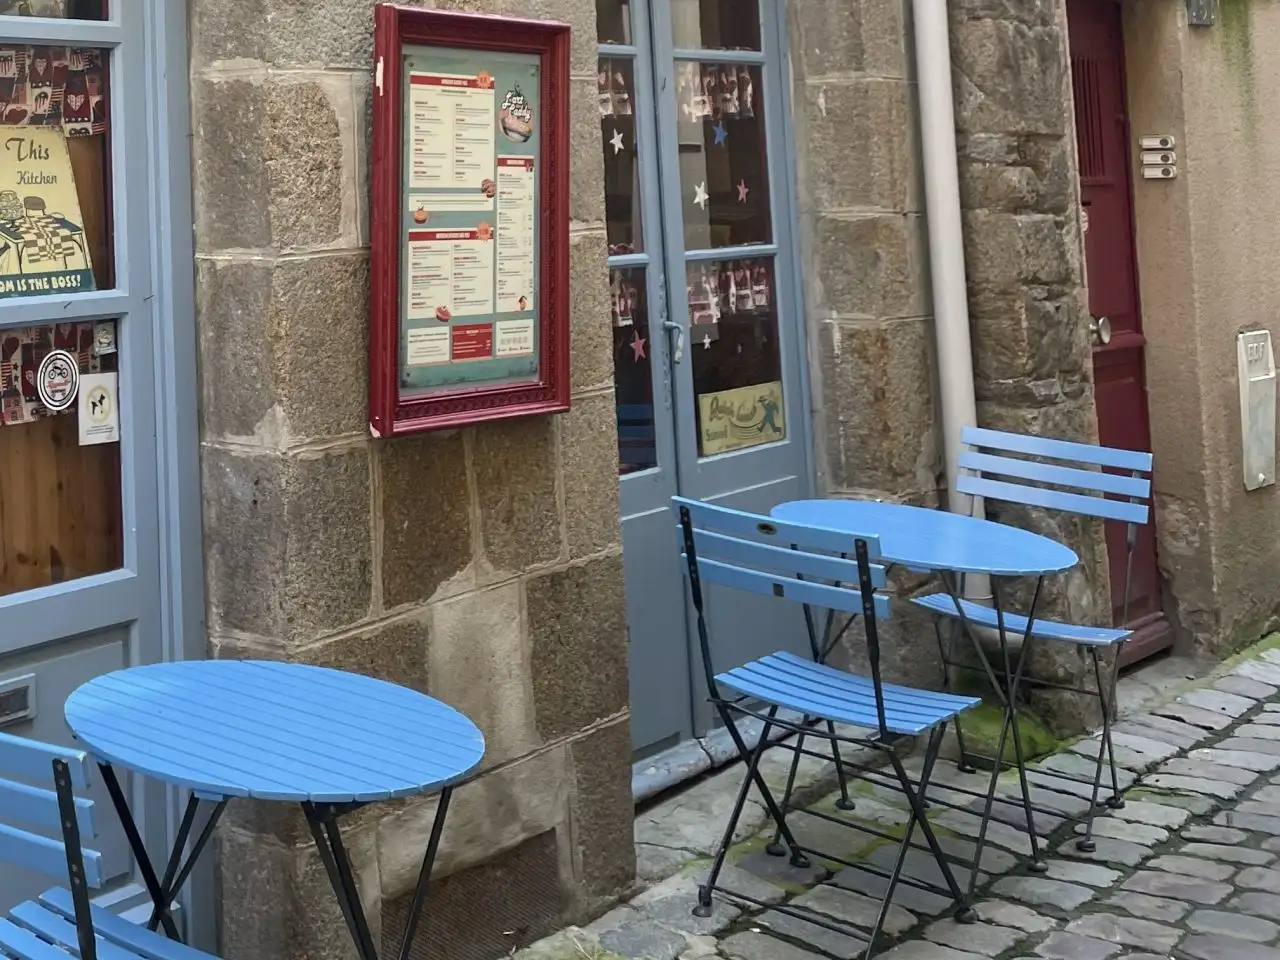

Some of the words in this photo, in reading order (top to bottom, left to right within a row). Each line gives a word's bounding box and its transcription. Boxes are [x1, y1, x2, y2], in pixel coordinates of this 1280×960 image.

[5, 138, 50, 161] This
[17, 171, 57, 185] Kitchen
[17, 278, 27, 291] IS
[27, 277, 49, 290] THE
[51, 274, 81, 289] BOSS!
